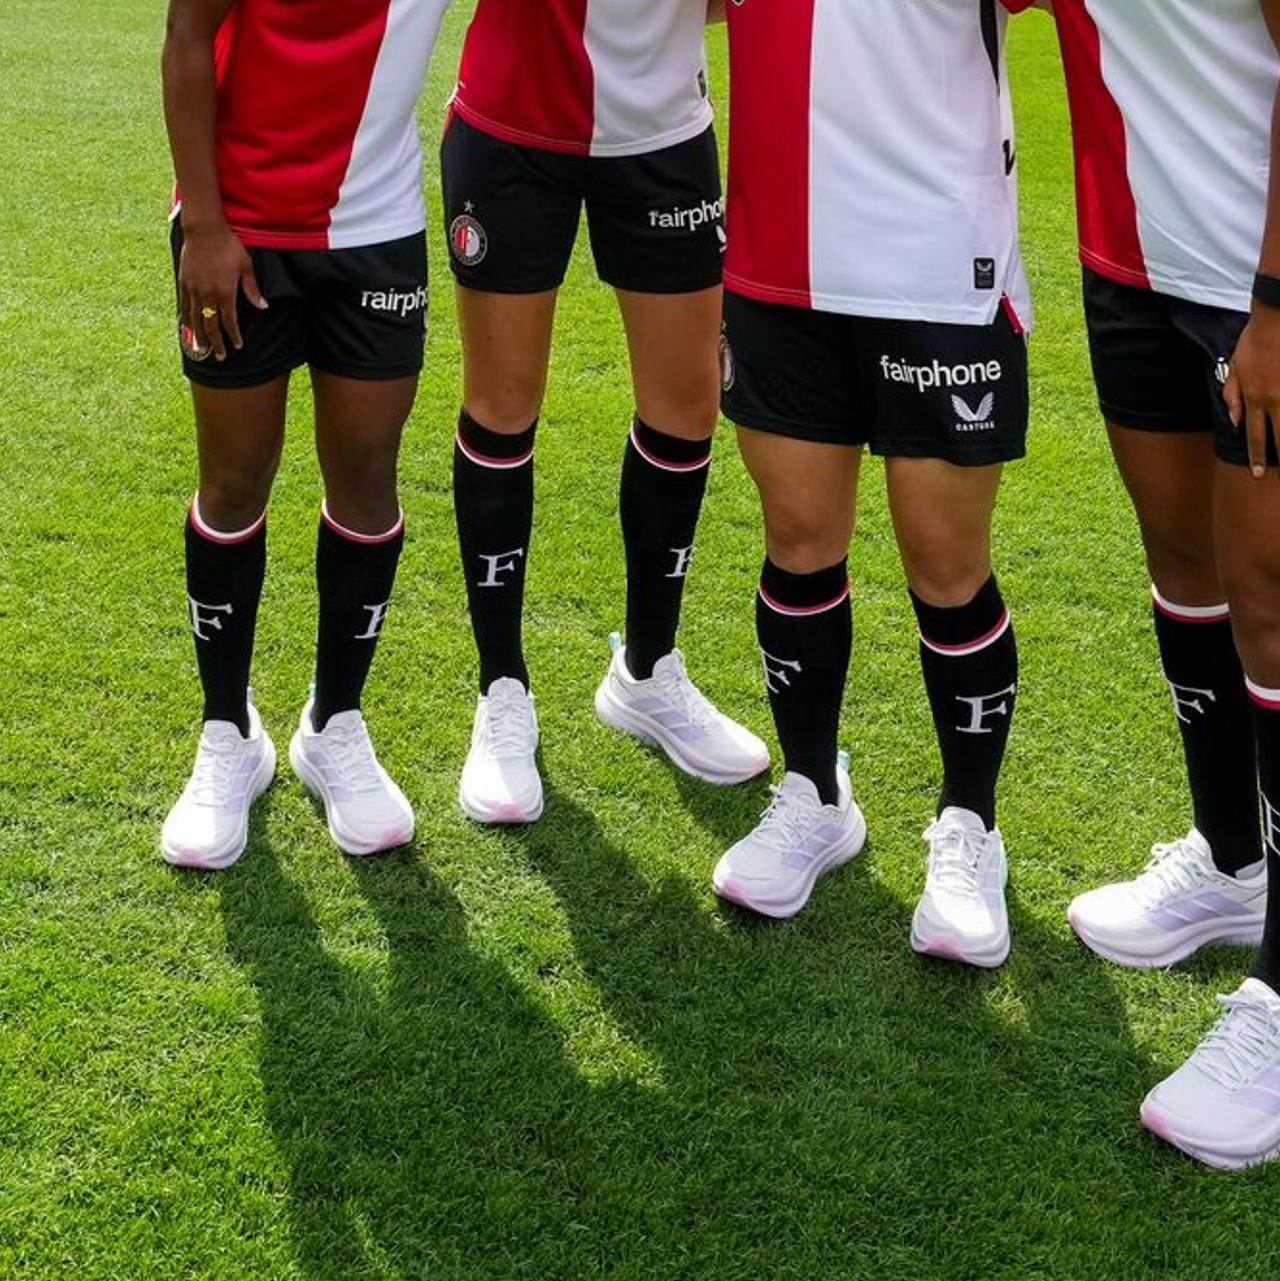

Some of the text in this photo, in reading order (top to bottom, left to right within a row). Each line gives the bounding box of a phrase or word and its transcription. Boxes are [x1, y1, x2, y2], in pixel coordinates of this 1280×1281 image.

[879, 355, 1003, 393] fairphone
[477, 547, 524, 587] F
[187, 595, 233, 641] F
[759, 646, 802, 694] F
[955, 683, 1017, 734] F
[1169, 681, 1216, 723] F
